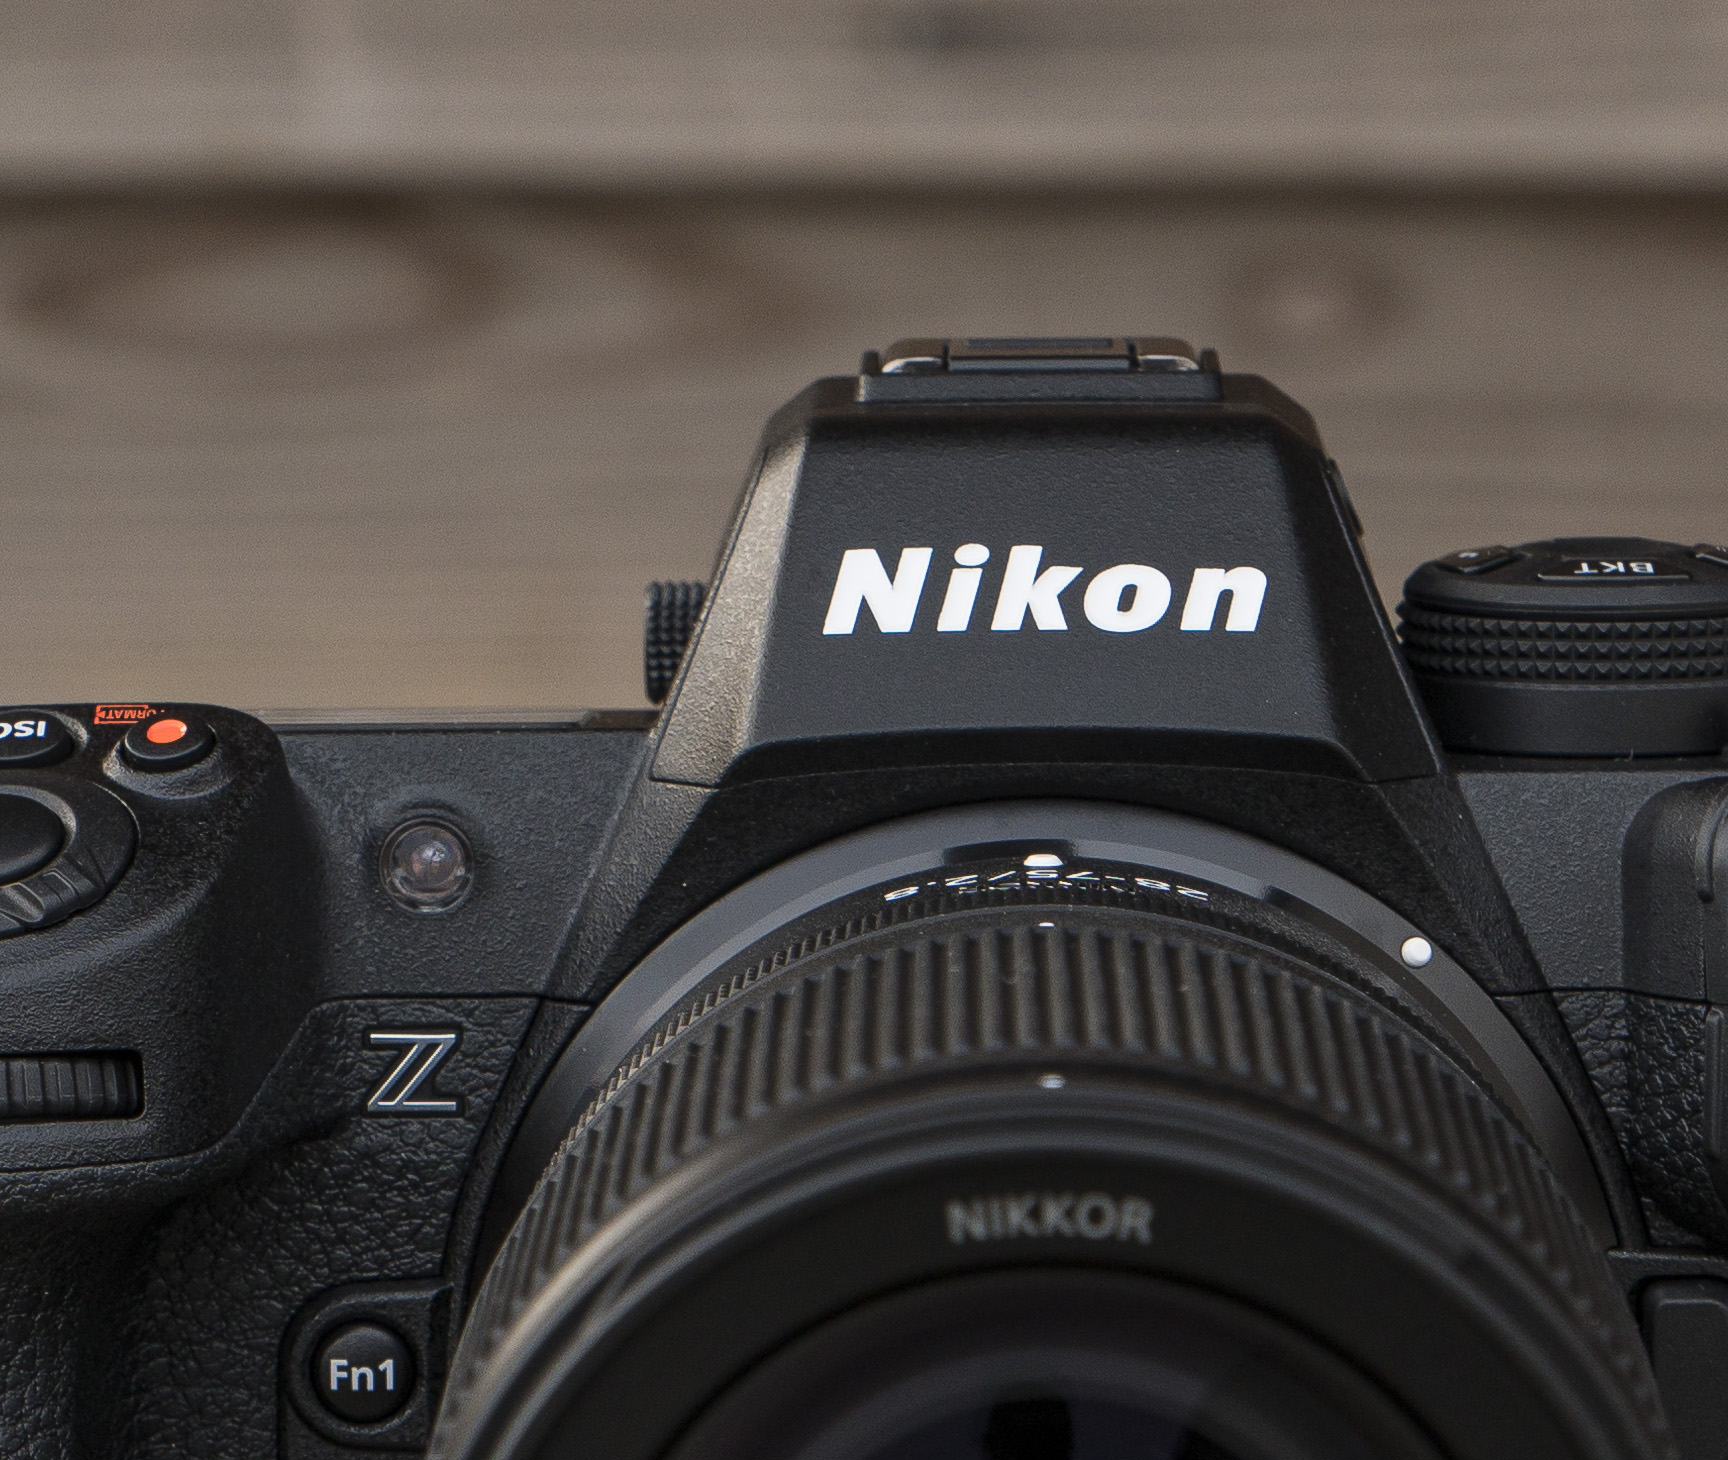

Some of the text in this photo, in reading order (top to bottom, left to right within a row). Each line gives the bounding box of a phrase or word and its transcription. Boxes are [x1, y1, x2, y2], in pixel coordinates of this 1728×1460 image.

[822, 543, 1268, 635] Nikon
[1574, 561, 1655, 575] BKT
[368, 1034, 457, 1112] Z
[946, 1193, 1153, 1245] NIKKOR
[330, 1359, 394, 1391] Fn1
